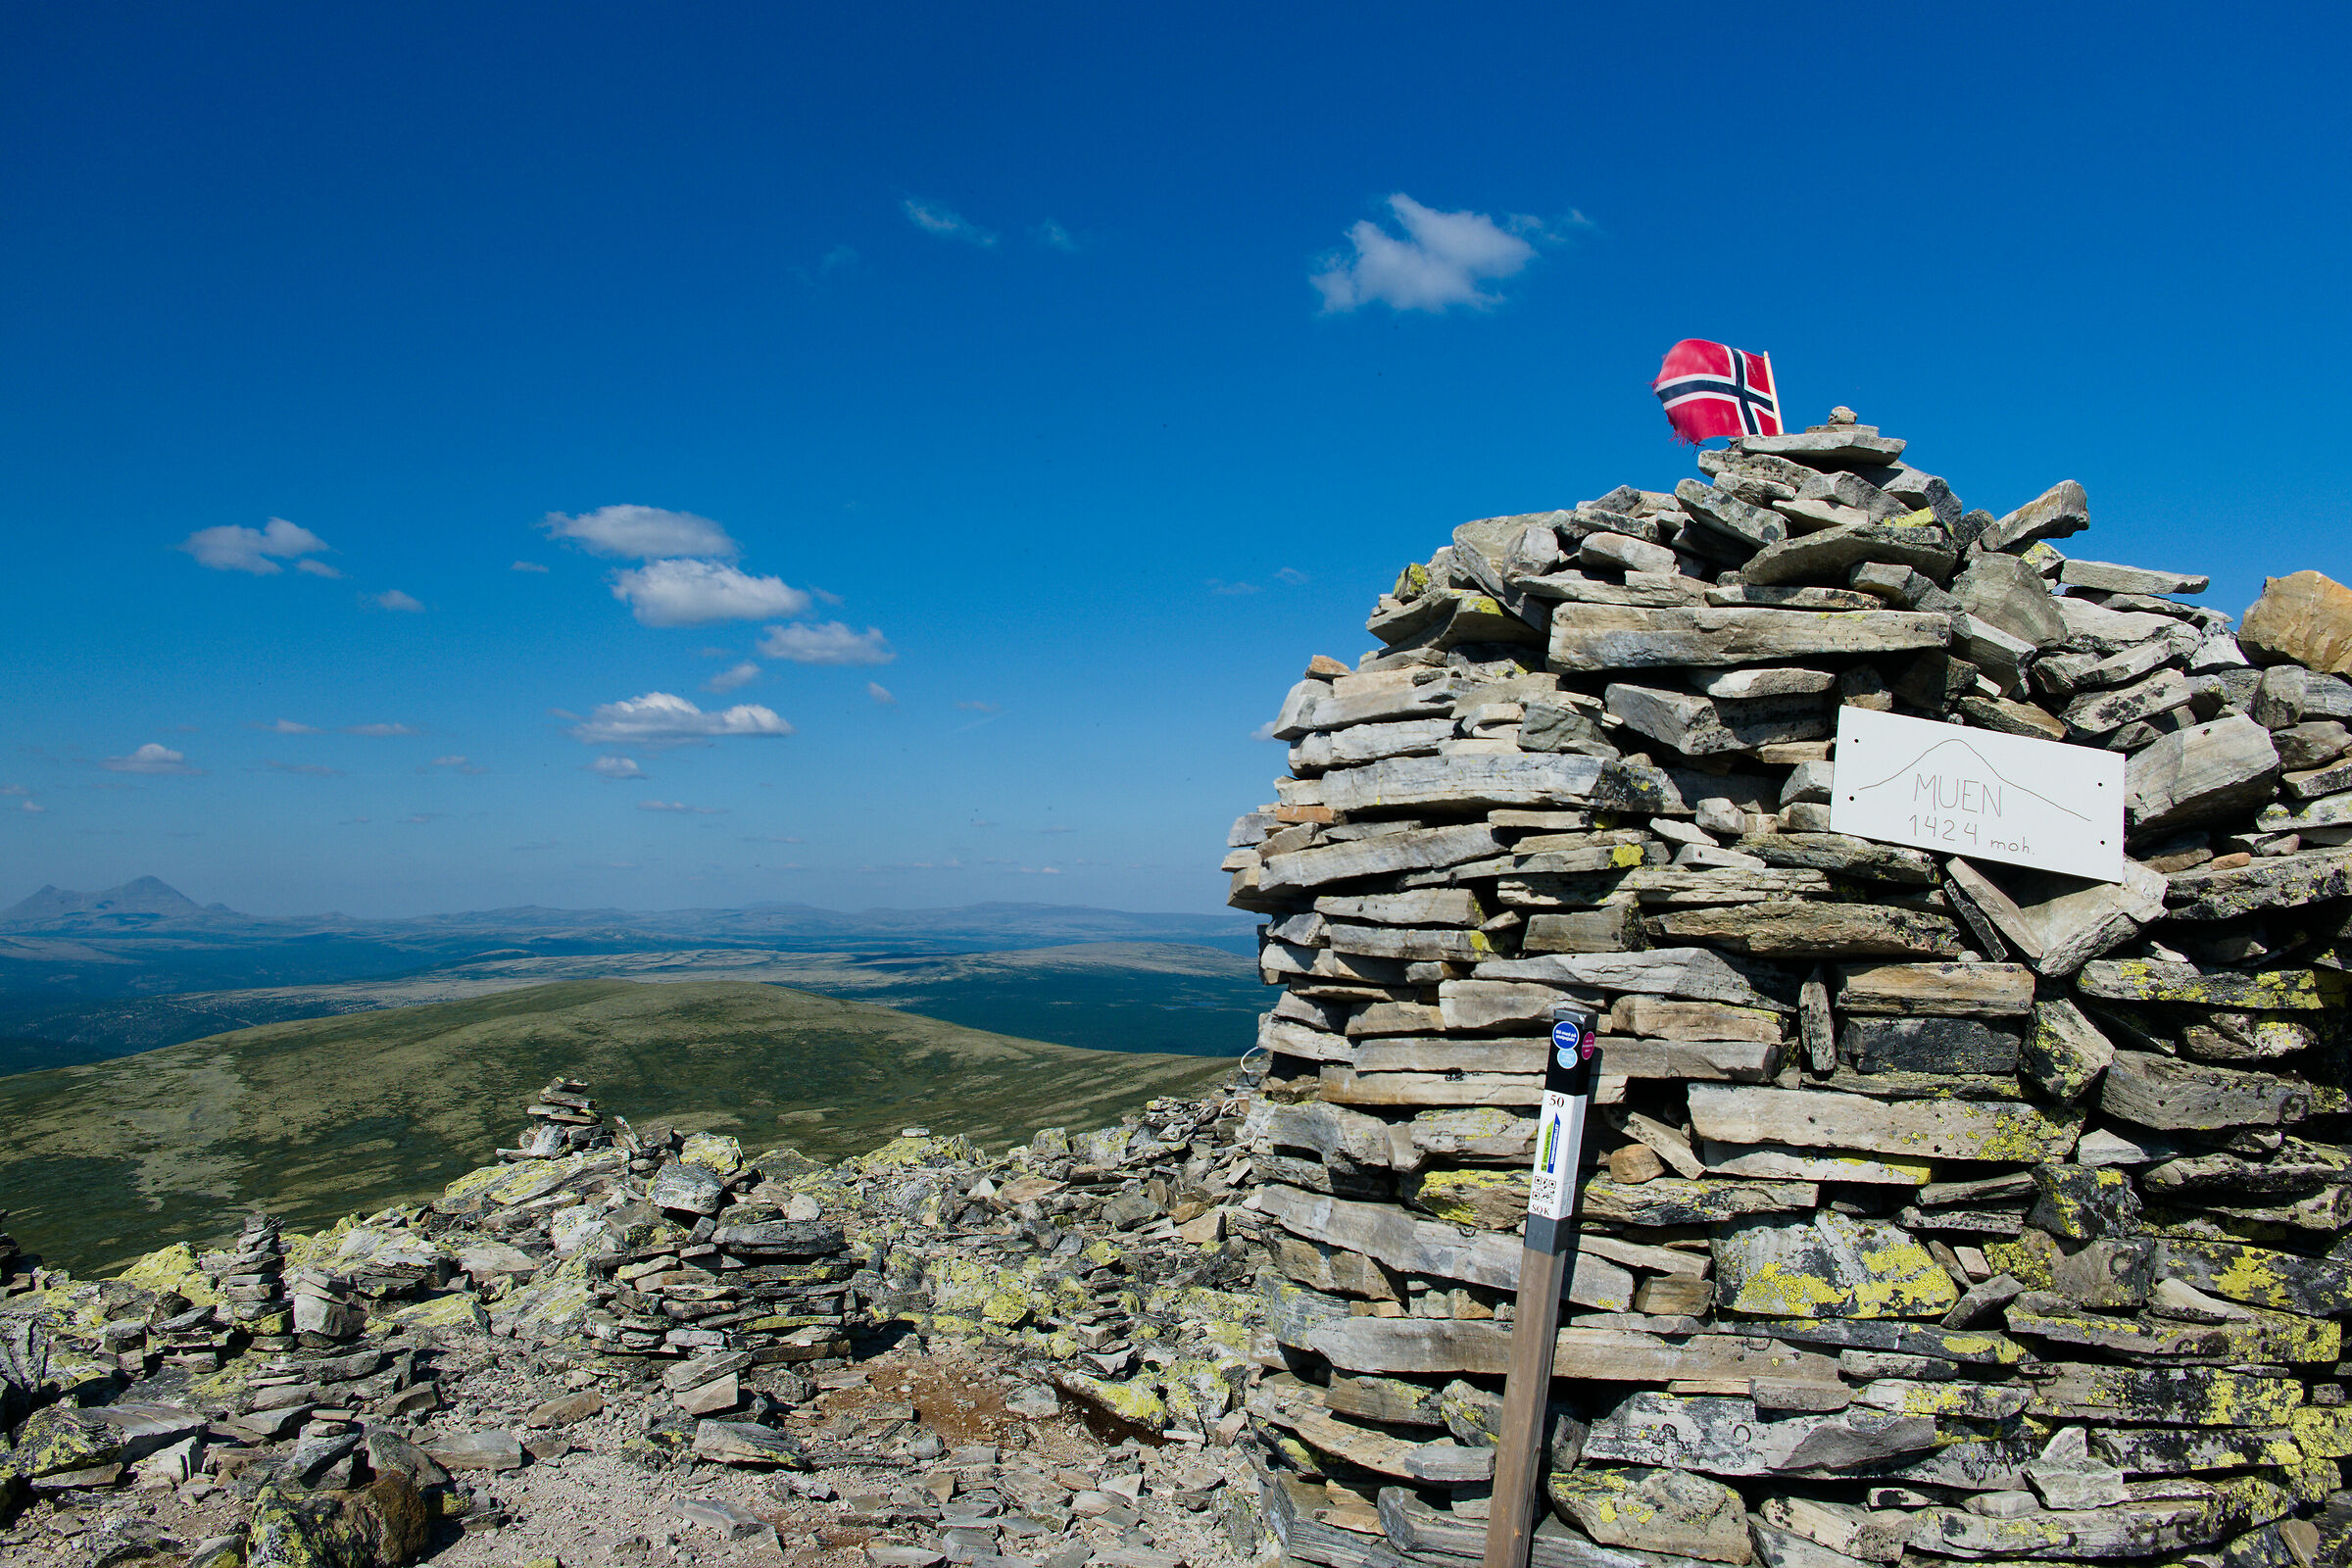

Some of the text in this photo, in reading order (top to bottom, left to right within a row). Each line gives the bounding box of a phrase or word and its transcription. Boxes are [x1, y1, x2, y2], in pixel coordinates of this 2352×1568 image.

[1913, 772, 2002, 818] MUEN
[1908, 814, 1978, 846] 1424
[1548, 1094, 1565, 1108] 50
[1531, 1204, 1550, 1216] SQK
